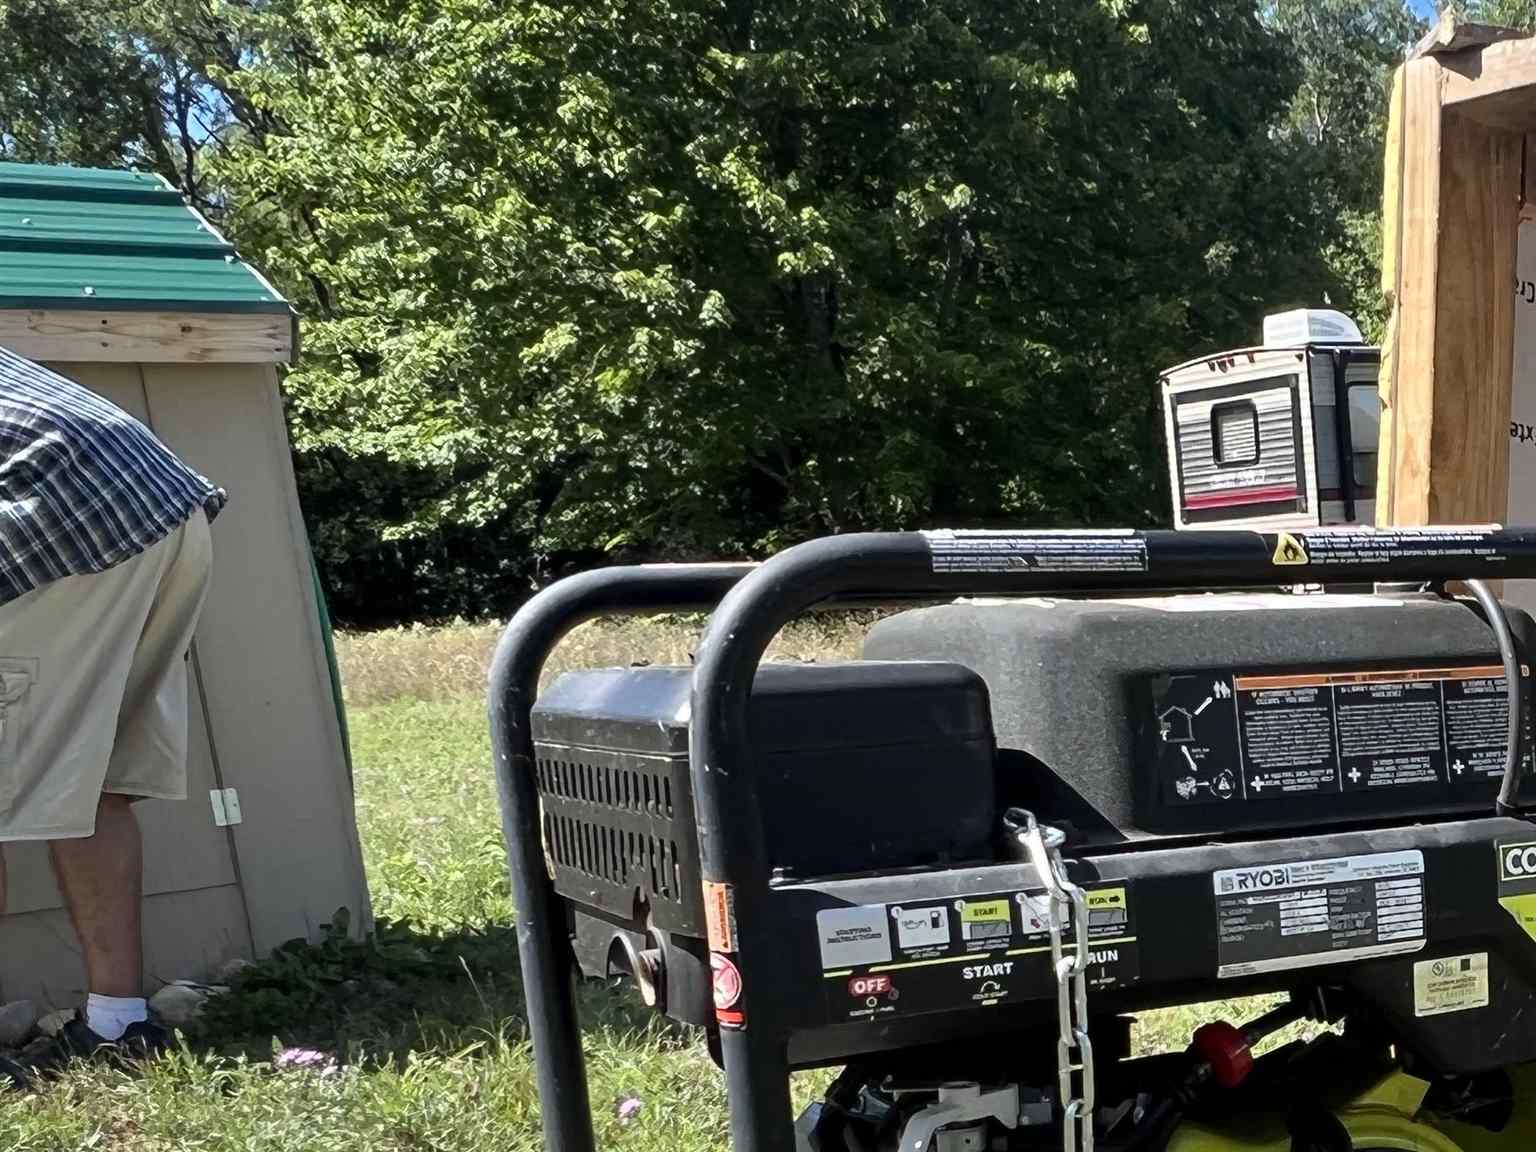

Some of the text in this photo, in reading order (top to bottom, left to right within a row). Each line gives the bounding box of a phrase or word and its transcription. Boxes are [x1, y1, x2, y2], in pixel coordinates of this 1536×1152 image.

[1235, 867, 1290, 889] RYOBI
[973, 906, 998, 917] START
[854, 950, 1119, 993] OFF START RUN
